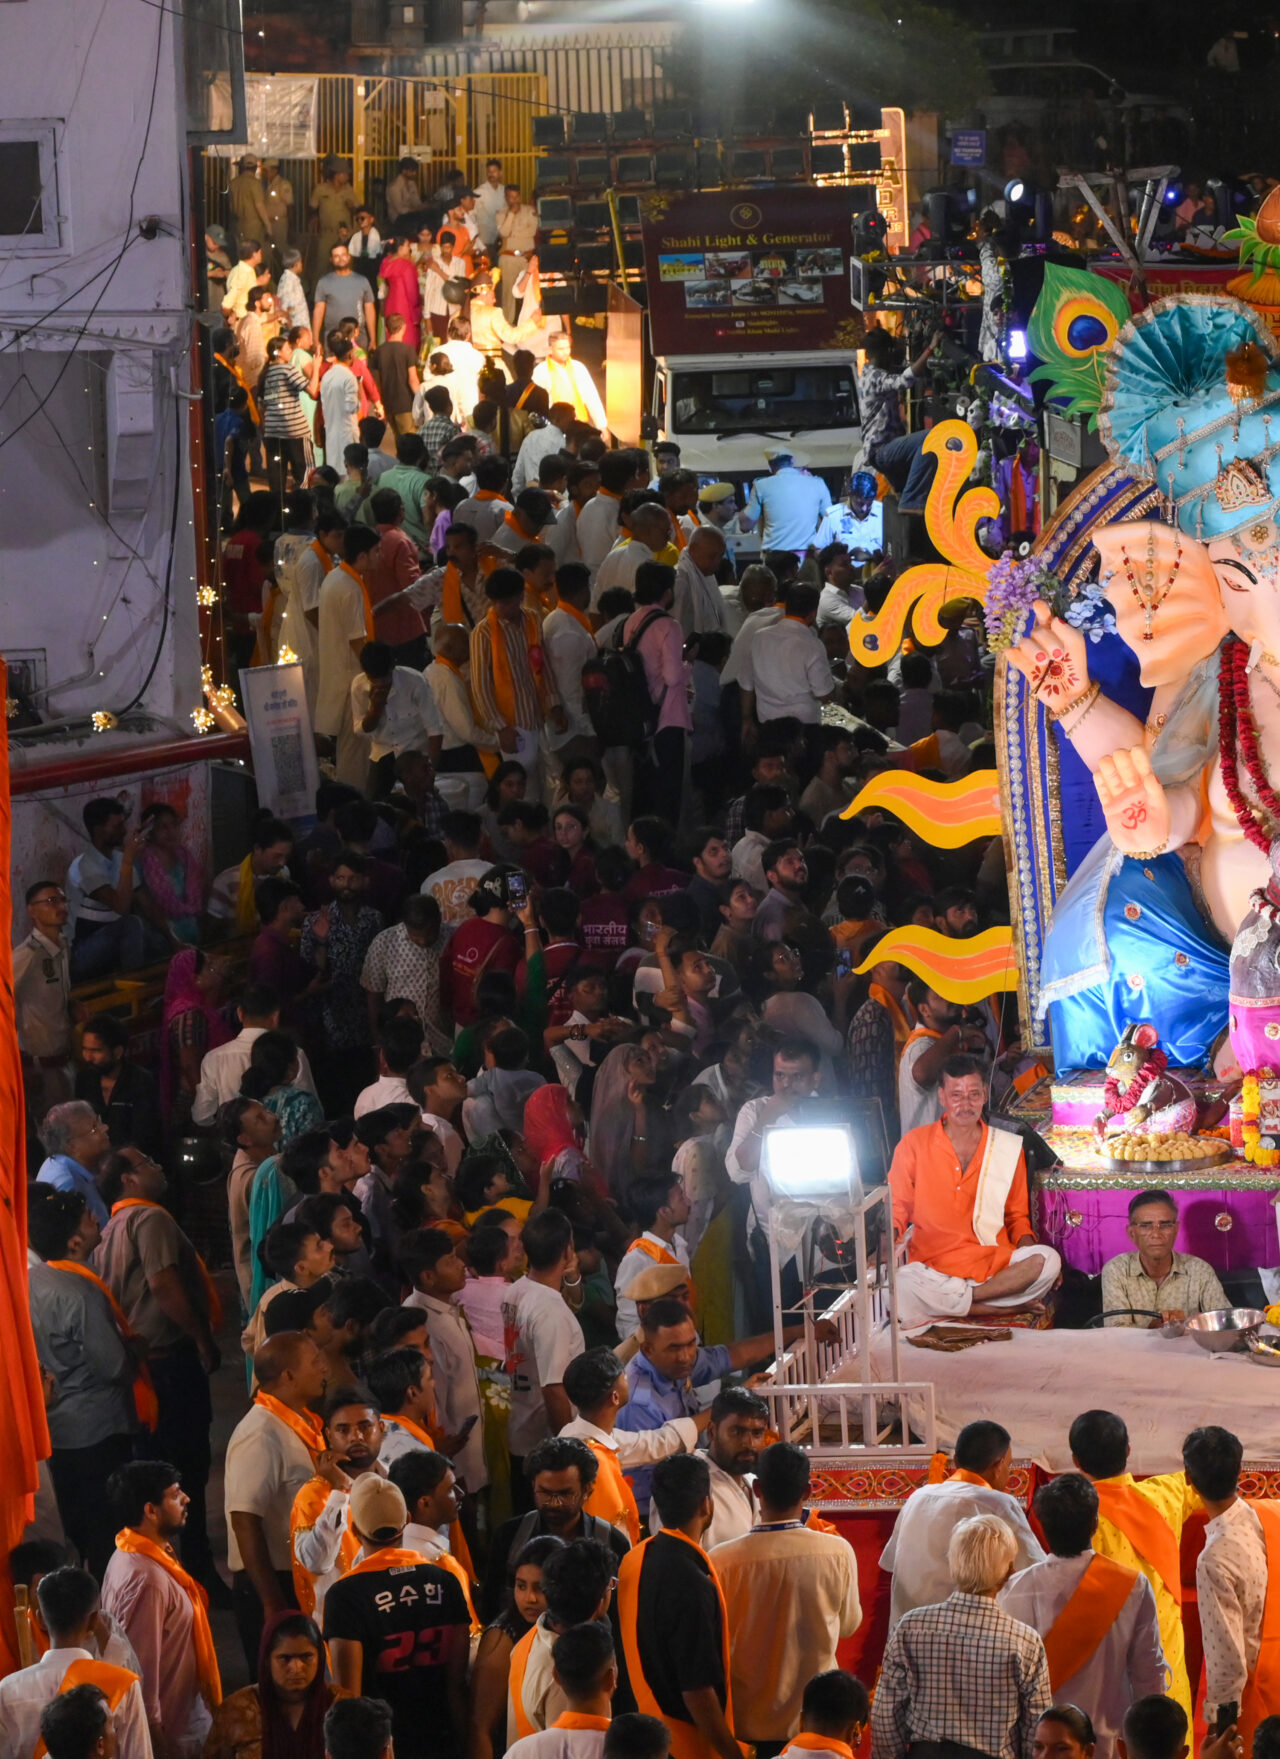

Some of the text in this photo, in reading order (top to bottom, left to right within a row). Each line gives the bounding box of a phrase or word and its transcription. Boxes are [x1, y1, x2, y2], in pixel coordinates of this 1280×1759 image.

[662, 232, 833, 248] Shahi Light & Generator
[583, 920, 628, 934] भारतीय
[374, 1582, 444, 1613] 우수한
[376, 1624, 456, 1673] 23
